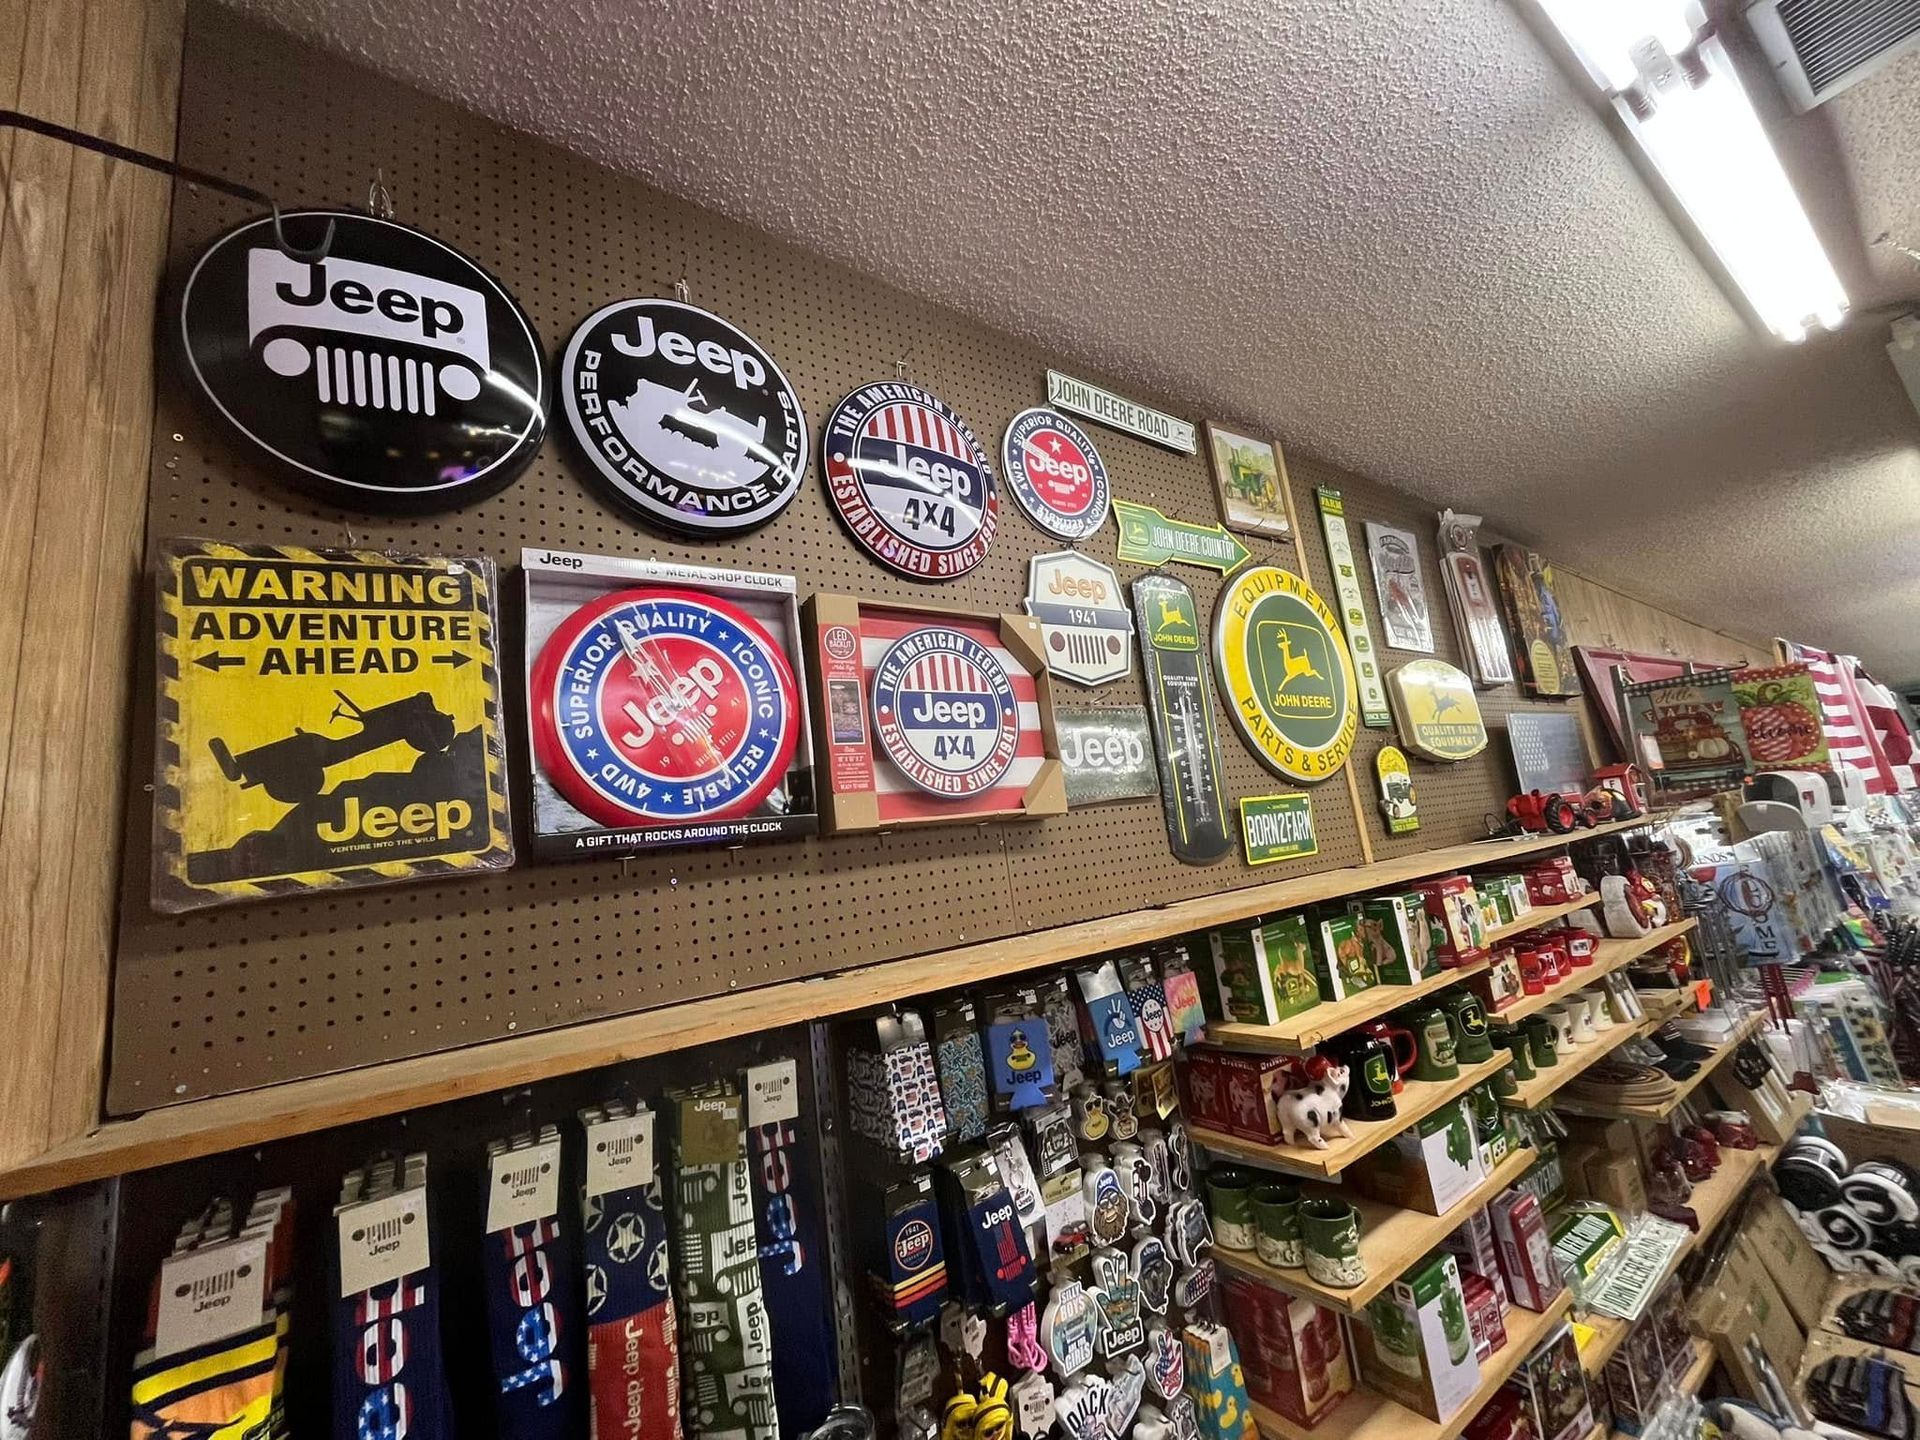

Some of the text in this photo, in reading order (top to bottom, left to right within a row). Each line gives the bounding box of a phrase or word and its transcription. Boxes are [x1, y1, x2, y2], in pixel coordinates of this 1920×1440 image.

[275, 263, 465, 337] Jeep
[611, 317, 766, 389] Jeep
[1058, 379, 1170, 439] JOHN DEERE ROAD
[580, 350, 806, 513] PERFORMANCE PARTS
[833, 383, 992, 475] THE AMERICAN LEGEND
[1013, 415, 1096, 465] SUPERIOR QUALITY
[880, 444, 971, 498] Jeep
[1023, 439, 1089, 485] Jeep
[1095, 475, 1106, 518] ICONIC
[833, 475, 998, 576] ESTABLISHED SINCE 1941
[1151, 525, 1237, 561] JOHN DEERE COUNTRY
[539, 552, 583, 569] Jeep
[191, 566, 462, 605] WARNING
[666, 568, 708, 580] METAL
[709, 571, 742, 583] SHOP
[745, 575, 783, 588] CLOCK
[1048, 569, 1107, 604] Jeep
[1069, 608, 1098, 626] 1941
[1233, 573, 1338, 633] EQUIPMENT
[191, 612, 472, 641] ADVENTURE
[832, 630, 848, 641] LED
[1154, 632, 1196, 645] JOHN DEERE
[259, 647, 419, 675] AHEAD
[570, 610, 712, 740] SUPERIOR QUALITY
[880, 633, 1009, 694] THE AMERICAN LEGEND
[731, 641, 774, 720] ICONIC
[621, 656, 724, 749] Jeep
[913, 693, 986, 728] Jeep
[1274, 693, 1332, 710] JOHN DEERE
[1242, 696, 1294, 765] PARTS
[1301, 755, 1312, 772] &
[1317, 701, 1358, 772] SERVICE
[1421, 725, 1457, 736] QUALITY
[1431, 736, 1477, 747] EQUIPMENT
[659, 755, 671, 768] 19
[881, 723, 1017, 793] ESTABLISHED SINCE 1941
[933, 735, 976, 760] 4X4
[1062, 726, 1145, 769] Jeep
[682, 744, 765, 806] RELIABLE
[317, 796, 472, 842] Jeep
[1246, 810, 1313, 848] BORN2FARM
[330, 835, 436, 854] VENTURE INTO THE WILD
[575, 821, 783, 848] A GIFT THAT ROCKS AROUND THE CLOCK
[1016, 988, 1036, 998] Jeep
[1175, 995, 1197, 1010] Jeep
[1143, 1009, 1163, 1022] Jeep
[1053, 1031, 1078, 1049] Jeep
[1108, 1030, 1135, 1048] Jeep
[1006, 1070, 1042, 1086] Jeep
[694, 1099, 727, 1113] Jeep
[764, 1094, 782, 1103] Jeep
[608, 1155, 632, 1167] Jeep
[512, 1186, 537, 1199] Jeep
[1098, 1175, 1113, 1188] Jeep
[982, 1204, 1013, 1229] Jeep
[369, 1239, 401, 1256] Jeep
[900, 1233, 929, 1258] Jeep
[1616, 1259, 1653, 1290] DEERE
[194, 1296, 231, 1313] Jeep
[1061, 1285, 1081, 1302] SILLY
[1602, 1285, 1633, 1312] JOHN
[1060, 1296, 1086, 1320] BOYS
[746, 1301, 765, 1353] Jeep
[1108, 1326, 1140, 1349] Jeep
[622, 1320, 643, 1375] Jeep
[1065, 1343, 1091, 1371] GIRLS
[1066, 1387, 1111, 1430] DUCK
